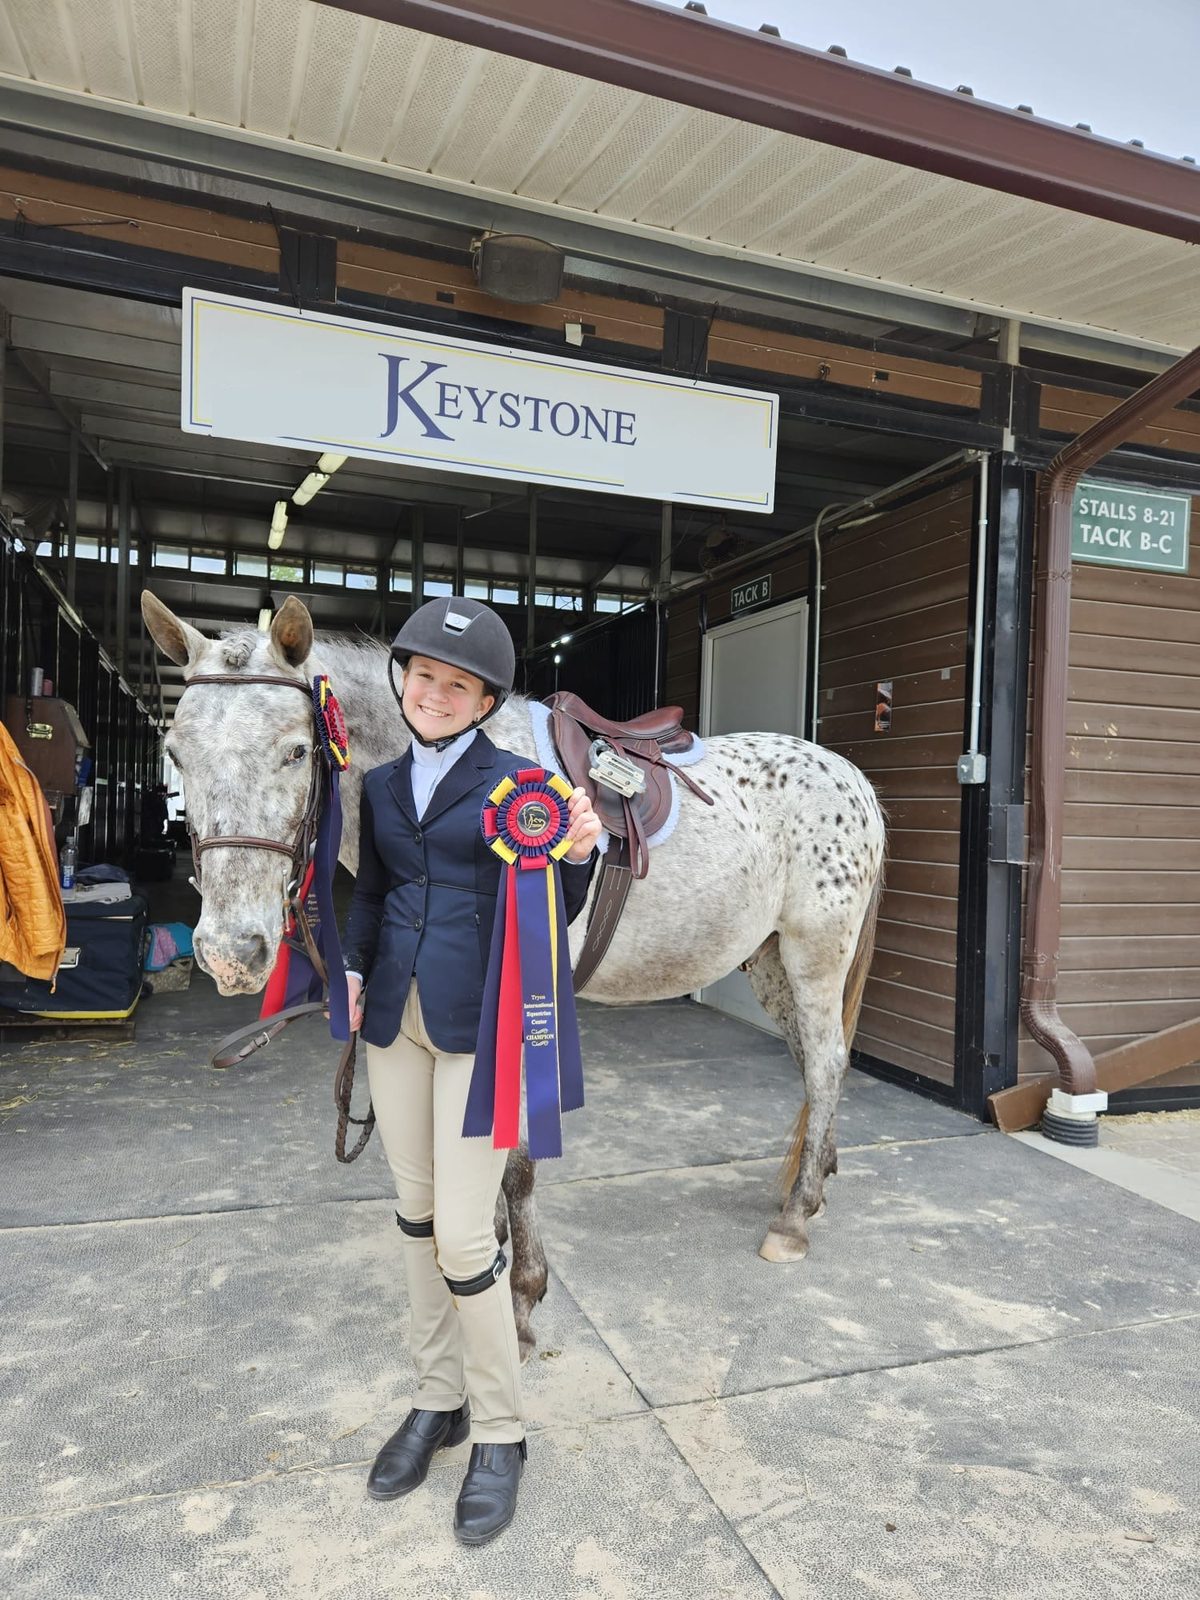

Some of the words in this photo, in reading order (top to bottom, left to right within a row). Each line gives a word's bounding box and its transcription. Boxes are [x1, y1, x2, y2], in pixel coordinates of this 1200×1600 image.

[377, 353, 638, 446] KEYSTONE
[1079, 498, 1136, 521] STALLS
[1143, 508, 1175, 526] 8-21
[1080, 524, 1132, 548] TACK
[1140, 532, 1172, 554] B-C
[734, 585, 758, 607] TACK
[762, 581, 768, 597] B
